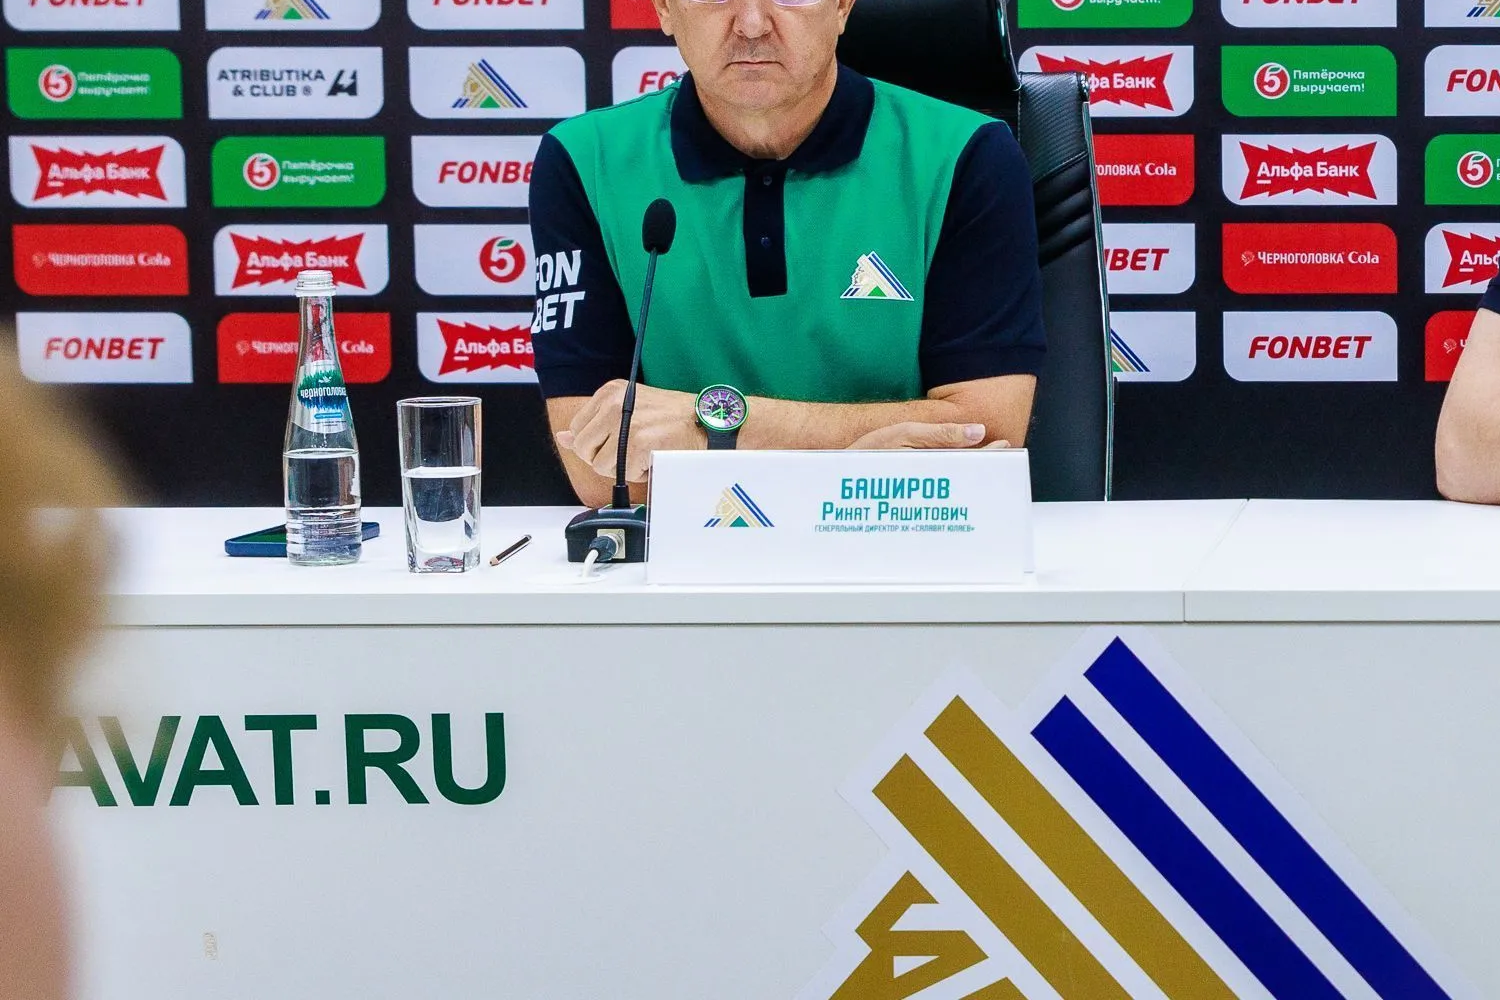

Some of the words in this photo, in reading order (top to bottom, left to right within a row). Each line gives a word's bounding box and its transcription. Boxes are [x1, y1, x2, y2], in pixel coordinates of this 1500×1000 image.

[217, 69, 325, 81] ATRIBUTIKA
[1113, 73, 1156, 89] Банк
[1293, 69, 1365, 81] Пятёрочка
[250, 85, 297, 97] CLUB
[1293, 82, 1364, 94] выручает!
[1144, 163, 1177, 176] Cola
[1257, 161, 1313, 183] Альфа
[1317, 161, 1359, 177] Банк
[1104, 248, 1169, 271] BET
[1347, 251, 1379, 264] Cola
[1459, 250, 1500, 271] Аль
[47, 338, 164, 359] FONBET
[453, 338, 510, 359] Альфа
[513, 339, 534, 354] Ба
[1249, 336, 1372, 358] FONBET
[841, 478, 950, 499] БАШИРОВ
